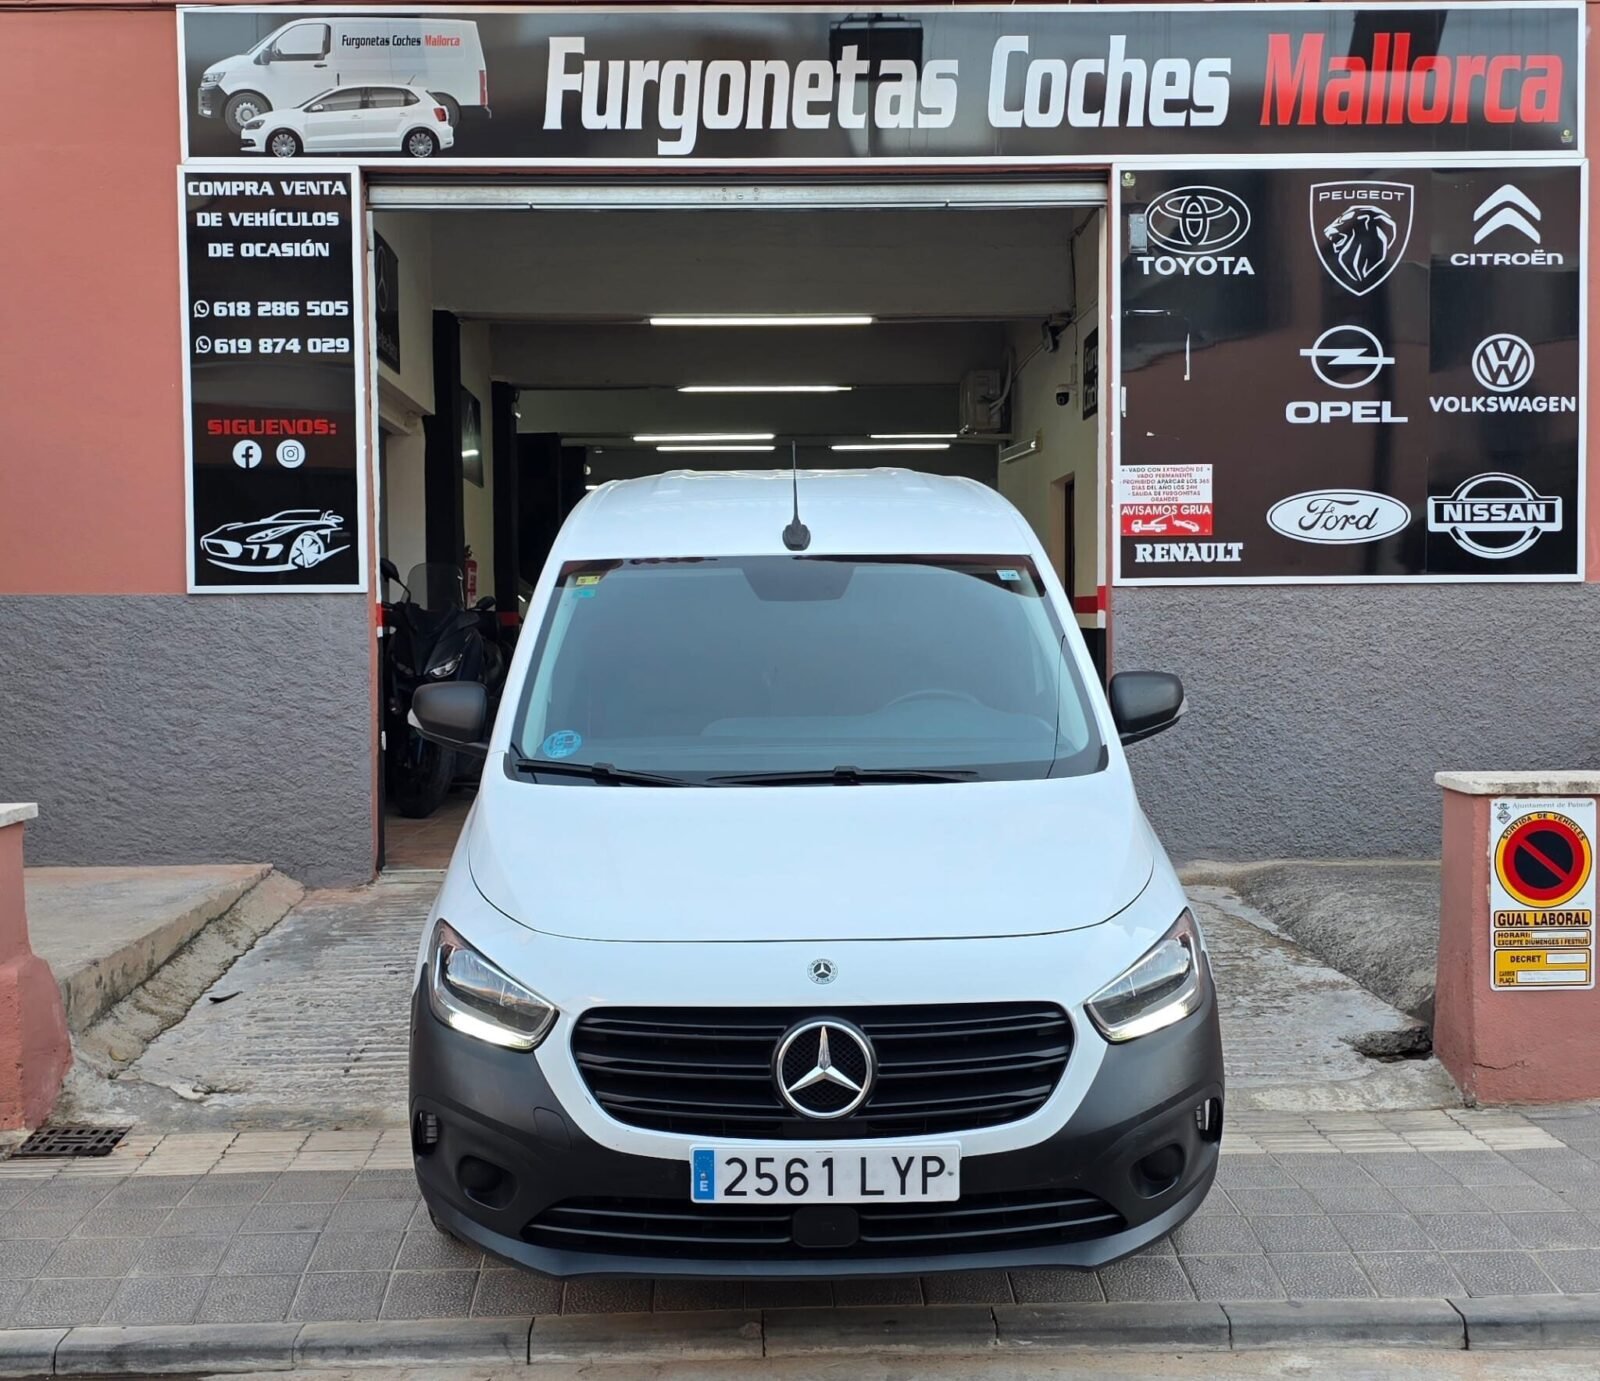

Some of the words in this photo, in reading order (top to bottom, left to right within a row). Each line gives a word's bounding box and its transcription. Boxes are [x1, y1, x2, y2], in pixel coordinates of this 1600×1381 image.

[341, 35, 391, 49] Furgonetas
[392, 35, 421, 46] Coches
[425, 35, 461, 47] Mallorca
[543, 36, 958, 156] Furgonetas
[988, 35, 1231, 128] Coches
[1260, 31, 1563, 127] Mallorca
[187, 181, 275, 196] COMPRA
[280, 180, 347, 196] VENTA
[1318, 190, 1405, 202] PEUGEOT
[196, 212, 223, 227] DE
[229, 208, 340, 227] VEHÍCULOS
[208, 242, 234, 258] DE
[240, 239, 330, 258] OCASIÓN
[1136, 255, 1255, 276] TOYOTA
[213, 301, 251, 317] 618
[257, 301, 300, 317] 286
[307, 301, 349, 317] 505
[214, 338, 252, 354] 619
[258, 338, 302, 354] 874
[308, 338, 350, 354] 029
[1285, 400, 1409, 424] OPEL
[1429, 396, 1576, 413] VOLKSWAGEN
[207, 418, 337, 436] SIGUENOS:
[1121, 505, 1178, 516] AVISAMOS
[1180, 504, 1212, 515] GRUA
[1297, 498, 1379, 531] Ford
[1443, 503, 1546, 522] NISSAN
[1134, 542, 1244, 564] RENAULT
[1512, 802, 1555, 810] Ajuntament
[1502, 816, 1532, 840] SORTIDA
[1553, 815, 1586, 841] VEHICLES
[1497, 913, 1530, 926] GUAL
[1534, 912, 1588, 926] LABORAL
[1525, 938, 1559, 946] DIUMENGES
[1510, 955, 1541, 963] DECRET
[724, 1157, 834, 1197] 2561
[860, 1156, 946, 1196] LYP
